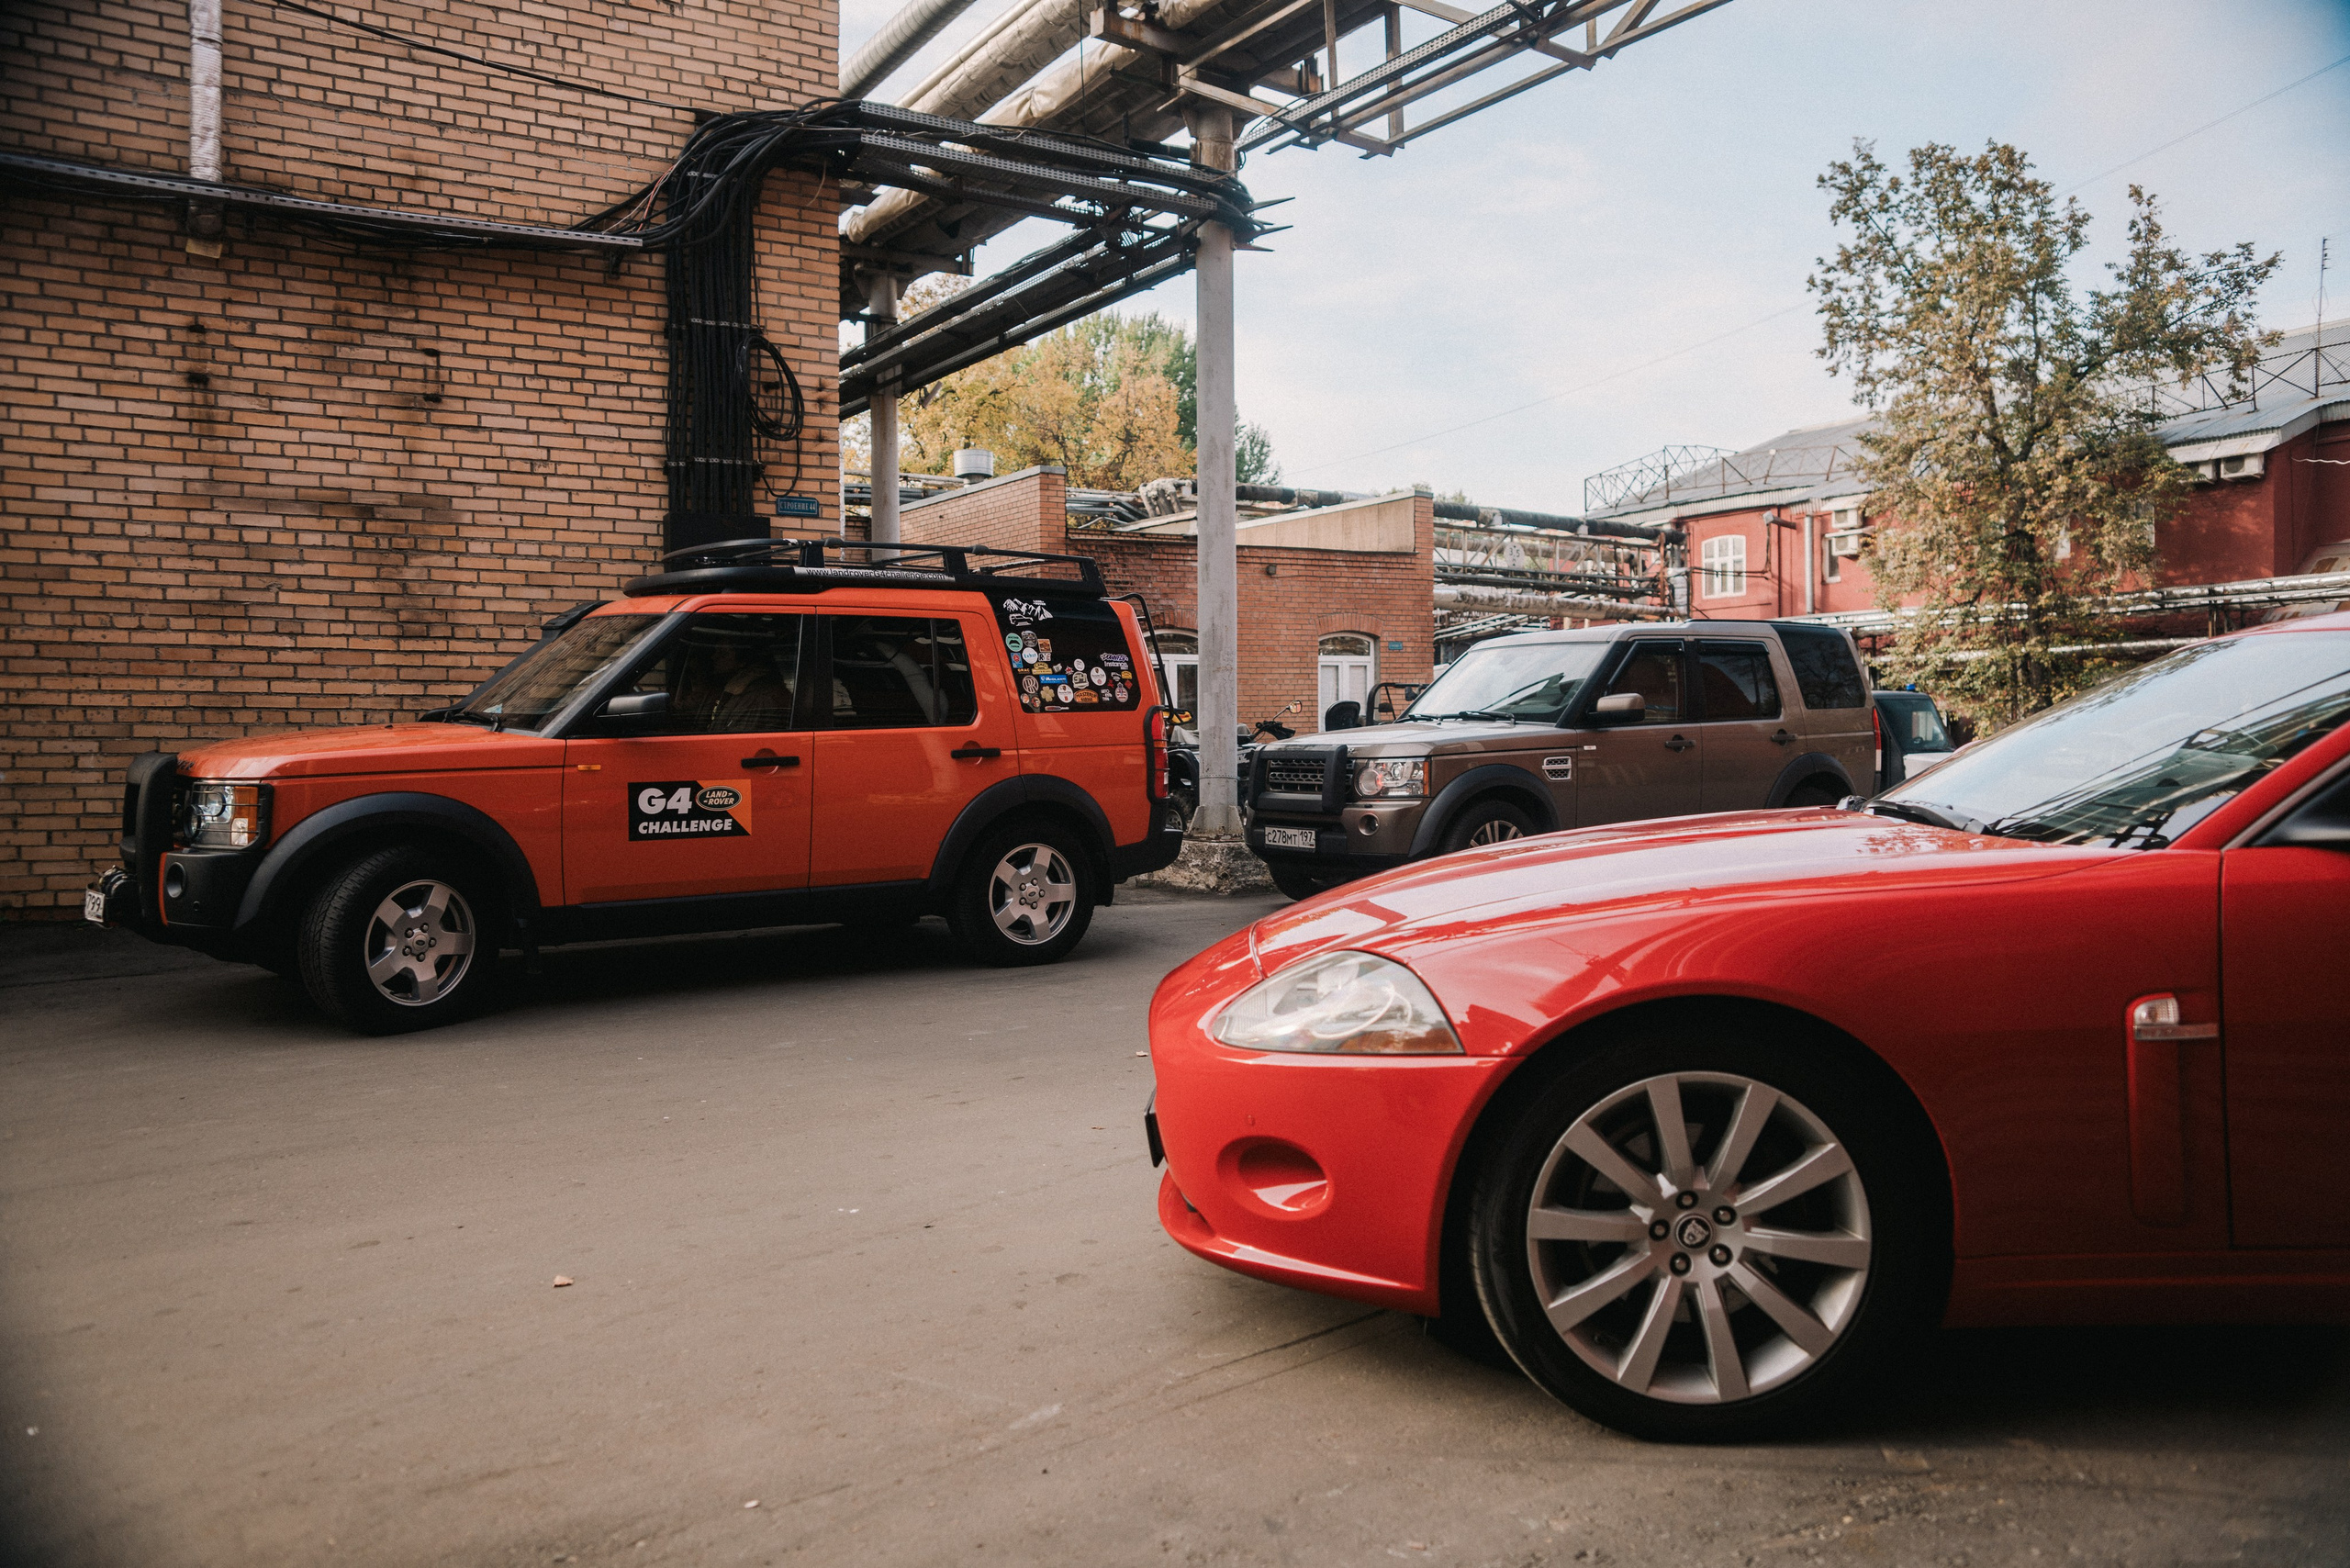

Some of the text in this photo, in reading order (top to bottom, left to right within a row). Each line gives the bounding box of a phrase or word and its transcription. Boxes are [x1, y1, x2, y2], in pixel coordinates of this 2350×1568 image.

[780, 501, 816, 510] СТРОЕНИЕ 44
[806, 568, 946, 580] www.landroverG4challenge.com
[706, 790, 727, 799] LAND
[638, 787, 693, 814] G4
[708, 797, 734, 805] ROVER
[638, 819, 733, 834] CHALLENGE
[1300, 831, 1313, 842] 197
